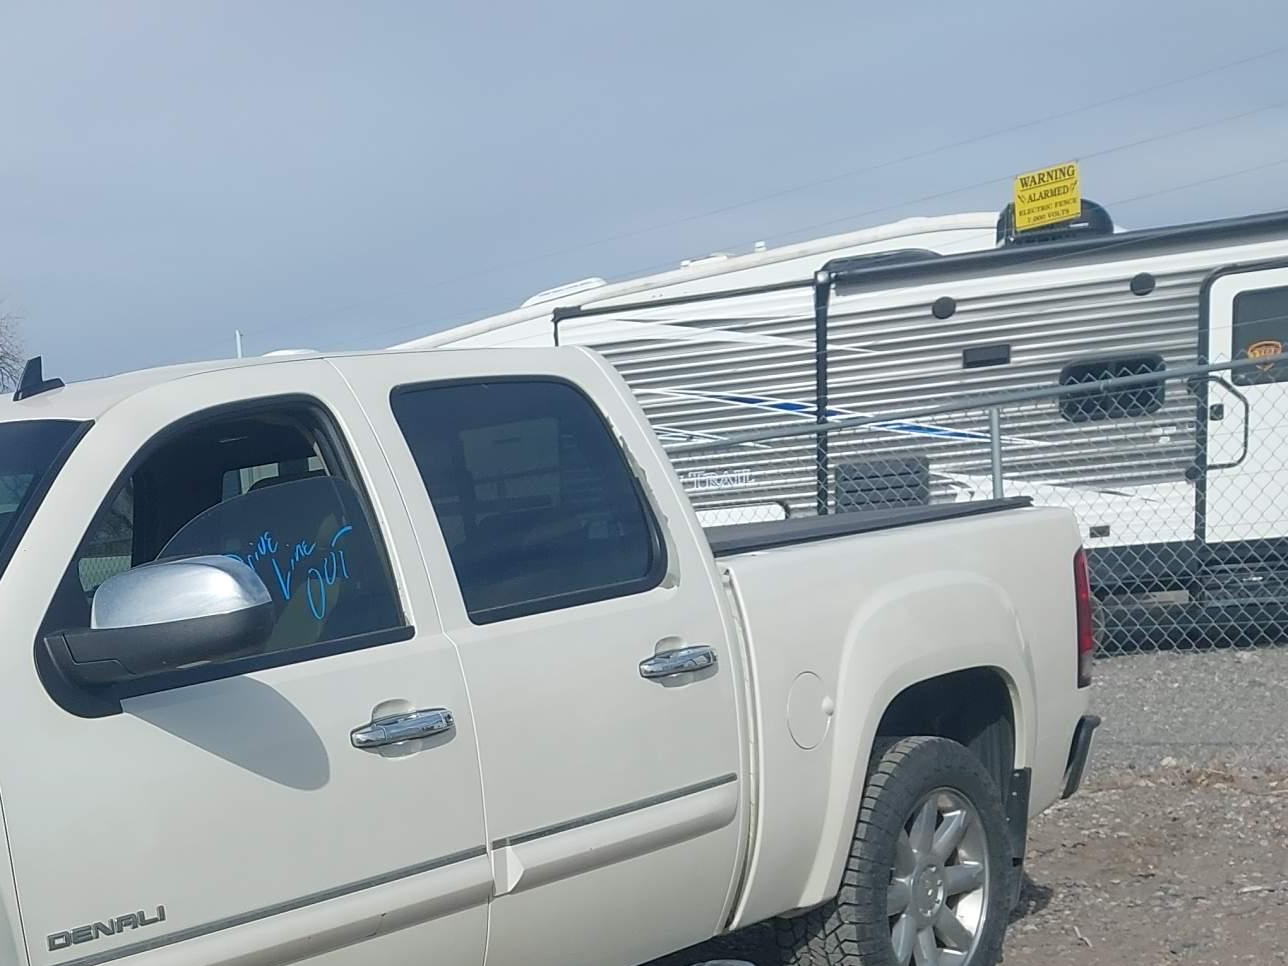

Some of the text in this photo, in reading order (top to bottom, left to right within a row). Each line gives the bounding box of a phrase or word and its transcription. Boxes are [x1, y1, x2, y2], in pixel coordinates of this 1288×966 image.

[1020, 164, 1075, 189] WARNING
[1027, 184, 1070, 203] ALARMED
[47, 904, 167, 952] DENALI
